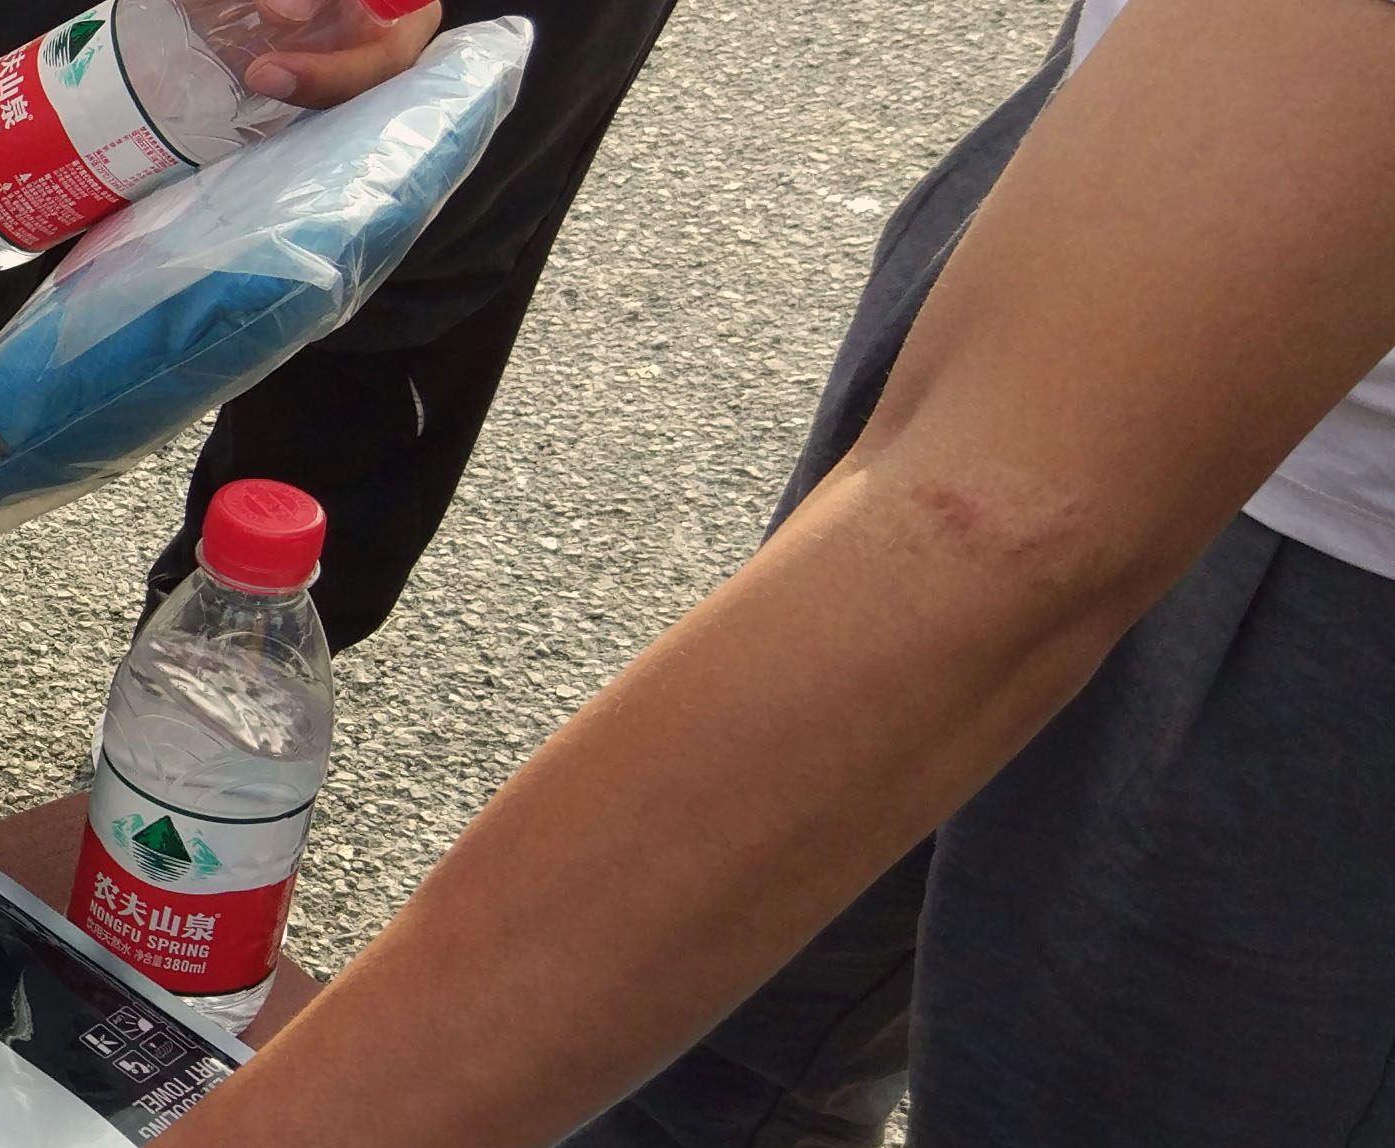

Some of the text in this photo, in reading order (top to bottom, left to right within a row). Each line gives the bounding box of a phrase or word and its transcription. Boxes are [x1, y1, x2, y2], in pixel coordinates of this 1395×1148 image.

[89, 899, 210, 958] NONGFU SPRING
[94, 872, 216, 941] 农夫山泉
[132, 1076, 191, 1115] TOWEL
